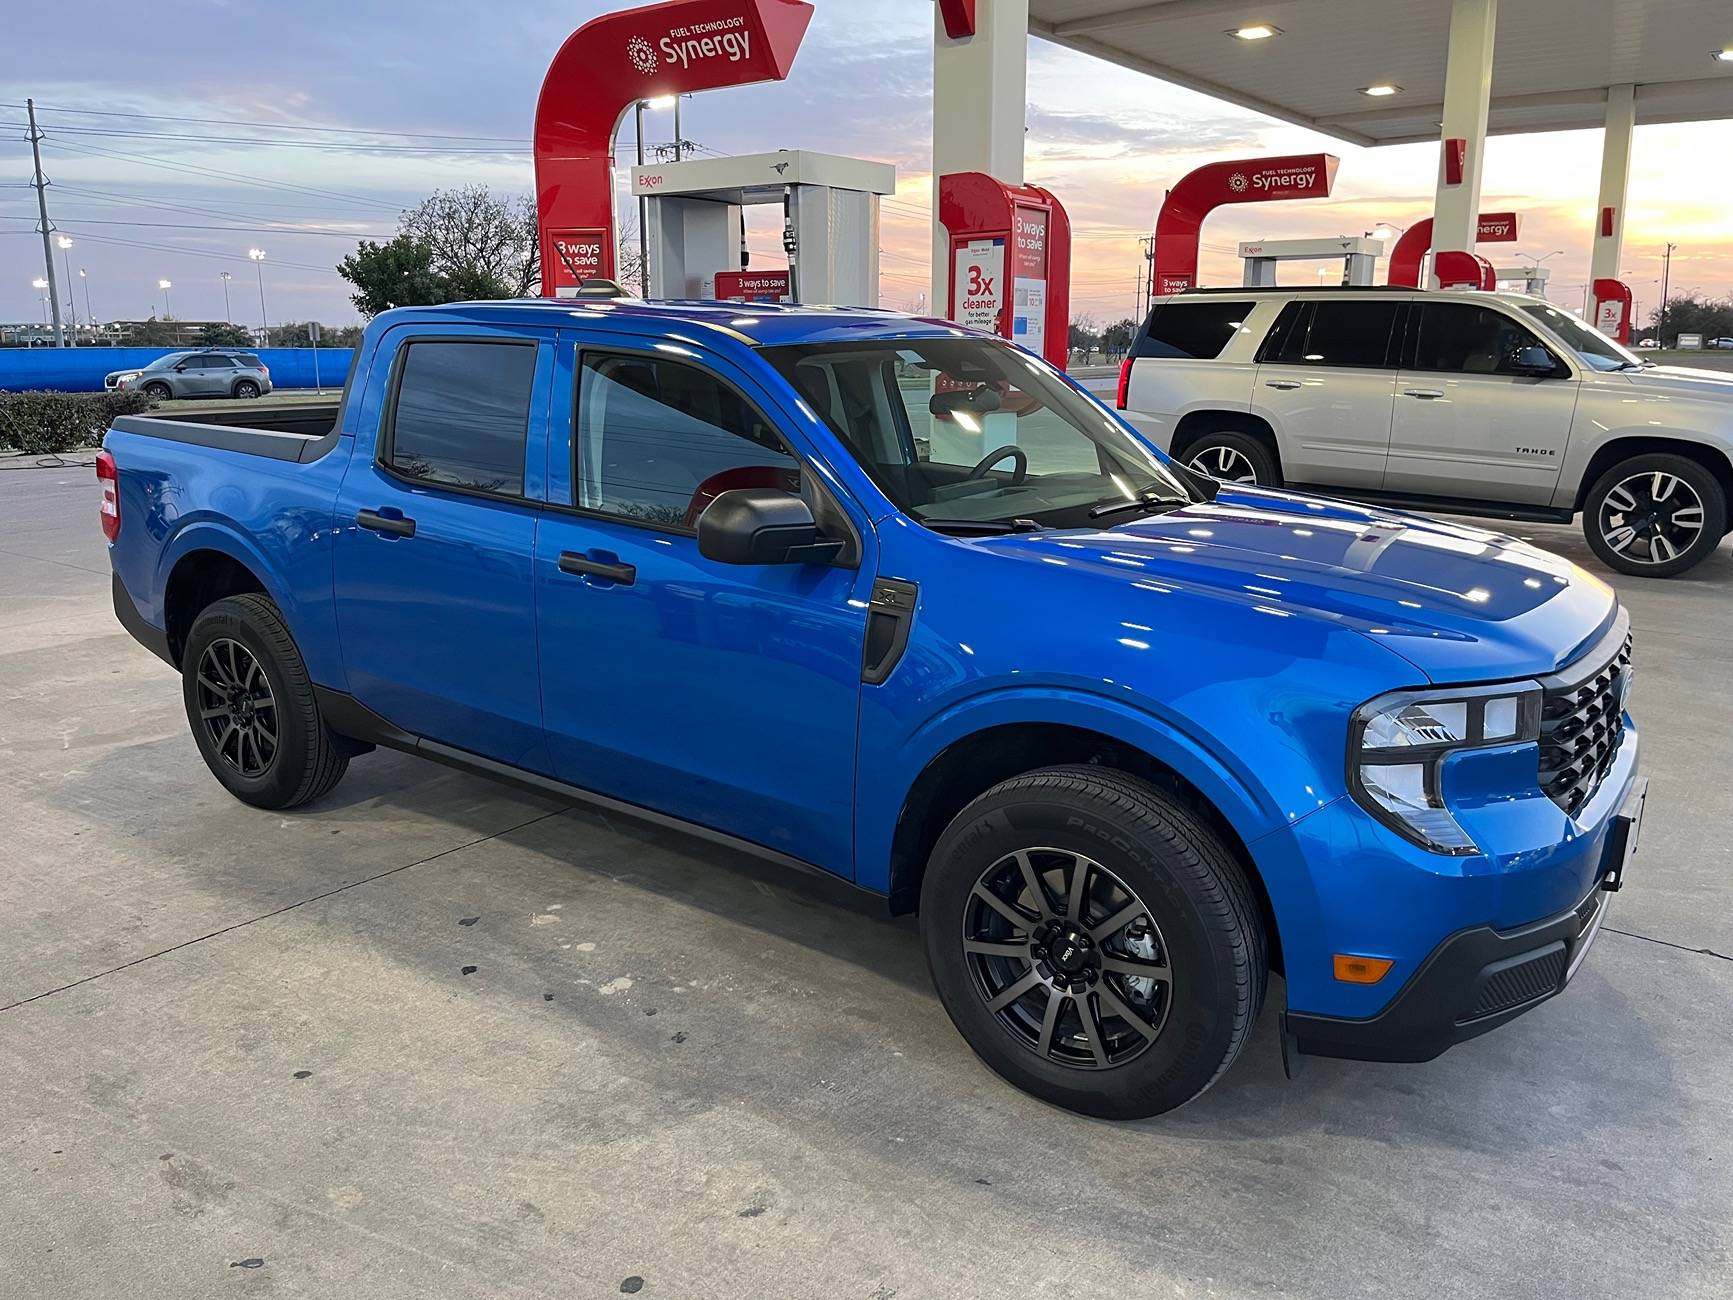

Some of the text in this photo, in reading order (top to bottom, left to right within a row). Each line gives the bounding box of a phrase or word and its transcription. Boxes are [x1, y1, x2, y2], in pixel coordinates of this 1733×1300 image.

[670, 16, 744, 38] FUEL TECHNOLOGY
[659, 30, 750, 69] Synergy
[1277, 166, 1316, 174] TECHNOLOGY
[639, 175, 663, 188] Exxon
[1252, 173, 1316, 191] Synergy
[1017, 217, 1045, 240] 3 ways
[1477, 225, 1509, 236] nergy
[1017, 235, 1043, 250] to save
[557, 241, 600, 258] 3 ways
[561, 256, 598, 265] to save
[738, 278, 786, 289] 3 ways to save
[967, 265, 994, 296] 3x
[1163, 279, 1188, 288] 3 ways
[962, 297, 997, 310] cleaner
[1604, 308, 1617, 319] 3x
[1515, 447, 1556, 456] TAHOE
